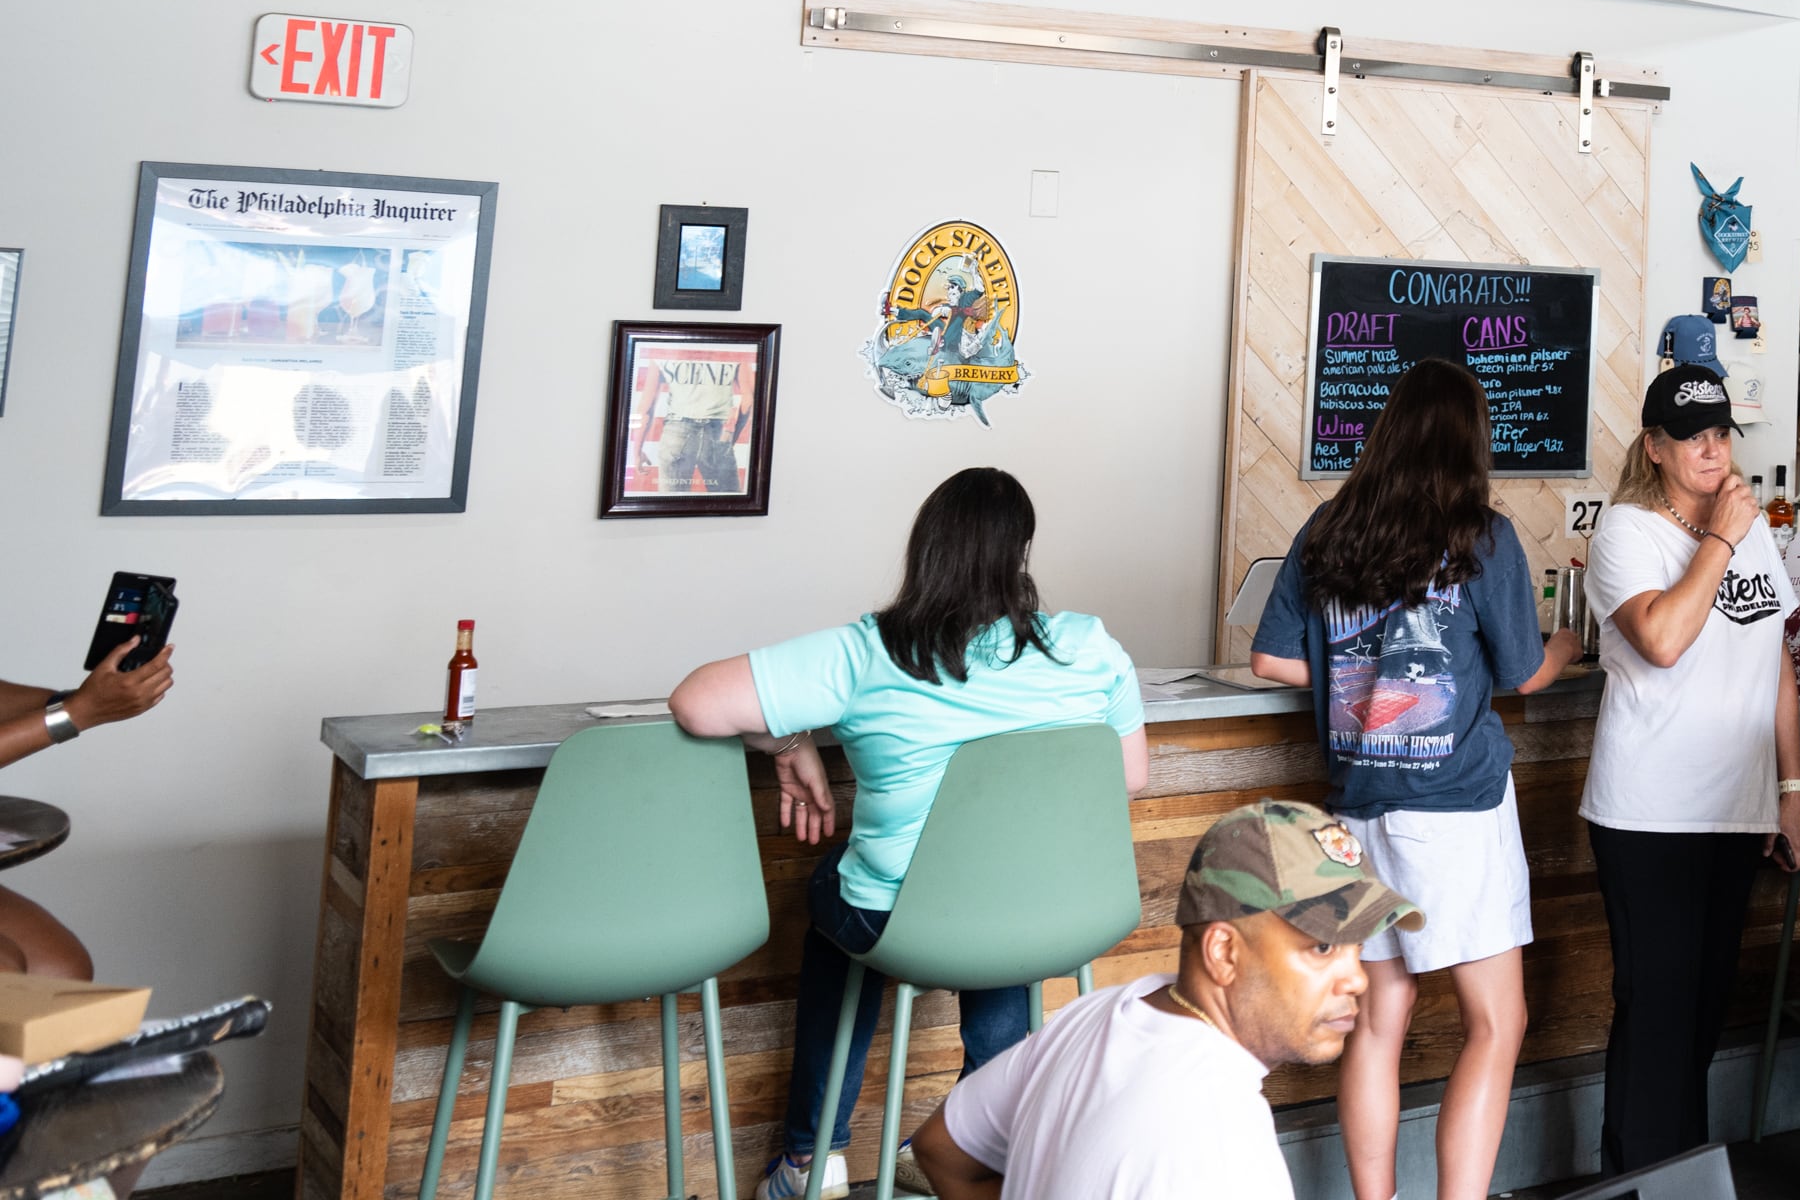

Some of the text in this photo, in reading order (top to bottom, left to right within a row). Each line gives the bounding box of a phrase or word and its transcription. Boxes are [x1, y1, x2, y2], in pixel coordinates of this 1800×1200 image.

[280, 18, 396, 99] EXIT
[188, 188, 457, 222] The Philadelphia Inquirer
[896, 229, 1011, 306] DOCK STREET
[1389, 269, 1531, 306] CONGRATS!!!
[1326, 311, 1400, 343] DRAFT
[1463, 315, 1527, 348] CANS
[1325, 349, 1369, 364] Summer
[1466, 348, 1571, 366] bohemian pilsner
[953, 367, 1015, 381] BREWERY
[1322, 364, 1365, 376] american
[1367, 363, 1386, 376] pale
[1387, 363, 1401, 374] ale
[1476, 364, 1504, 373] czech
[1506, 363, 1540, 375] pilsner
[1320, 381, 1390, 397] Barracuda
[1508, 387, 1543, 401] pilsner
[1320, 399, 1387, 410] hibiscus sou
[1501, 400, 1522, 412] IPA
[1317, 414, 1365, 436] Wine
[1490, 412, 1518, 421] erican
[1520, 412, 1534, 421] IPA
[1315, 442, 1340, 456] Red
[1514, 440, 1543, 458] lager
[1572, 500, 1603, 531] 27
[1361, 733, 1408, 756] WRITING
[1409, 732, 1454, 757] HISTORY
[1374, 760, 1387, 768] June
[1399, 761, 1411, 769] June
